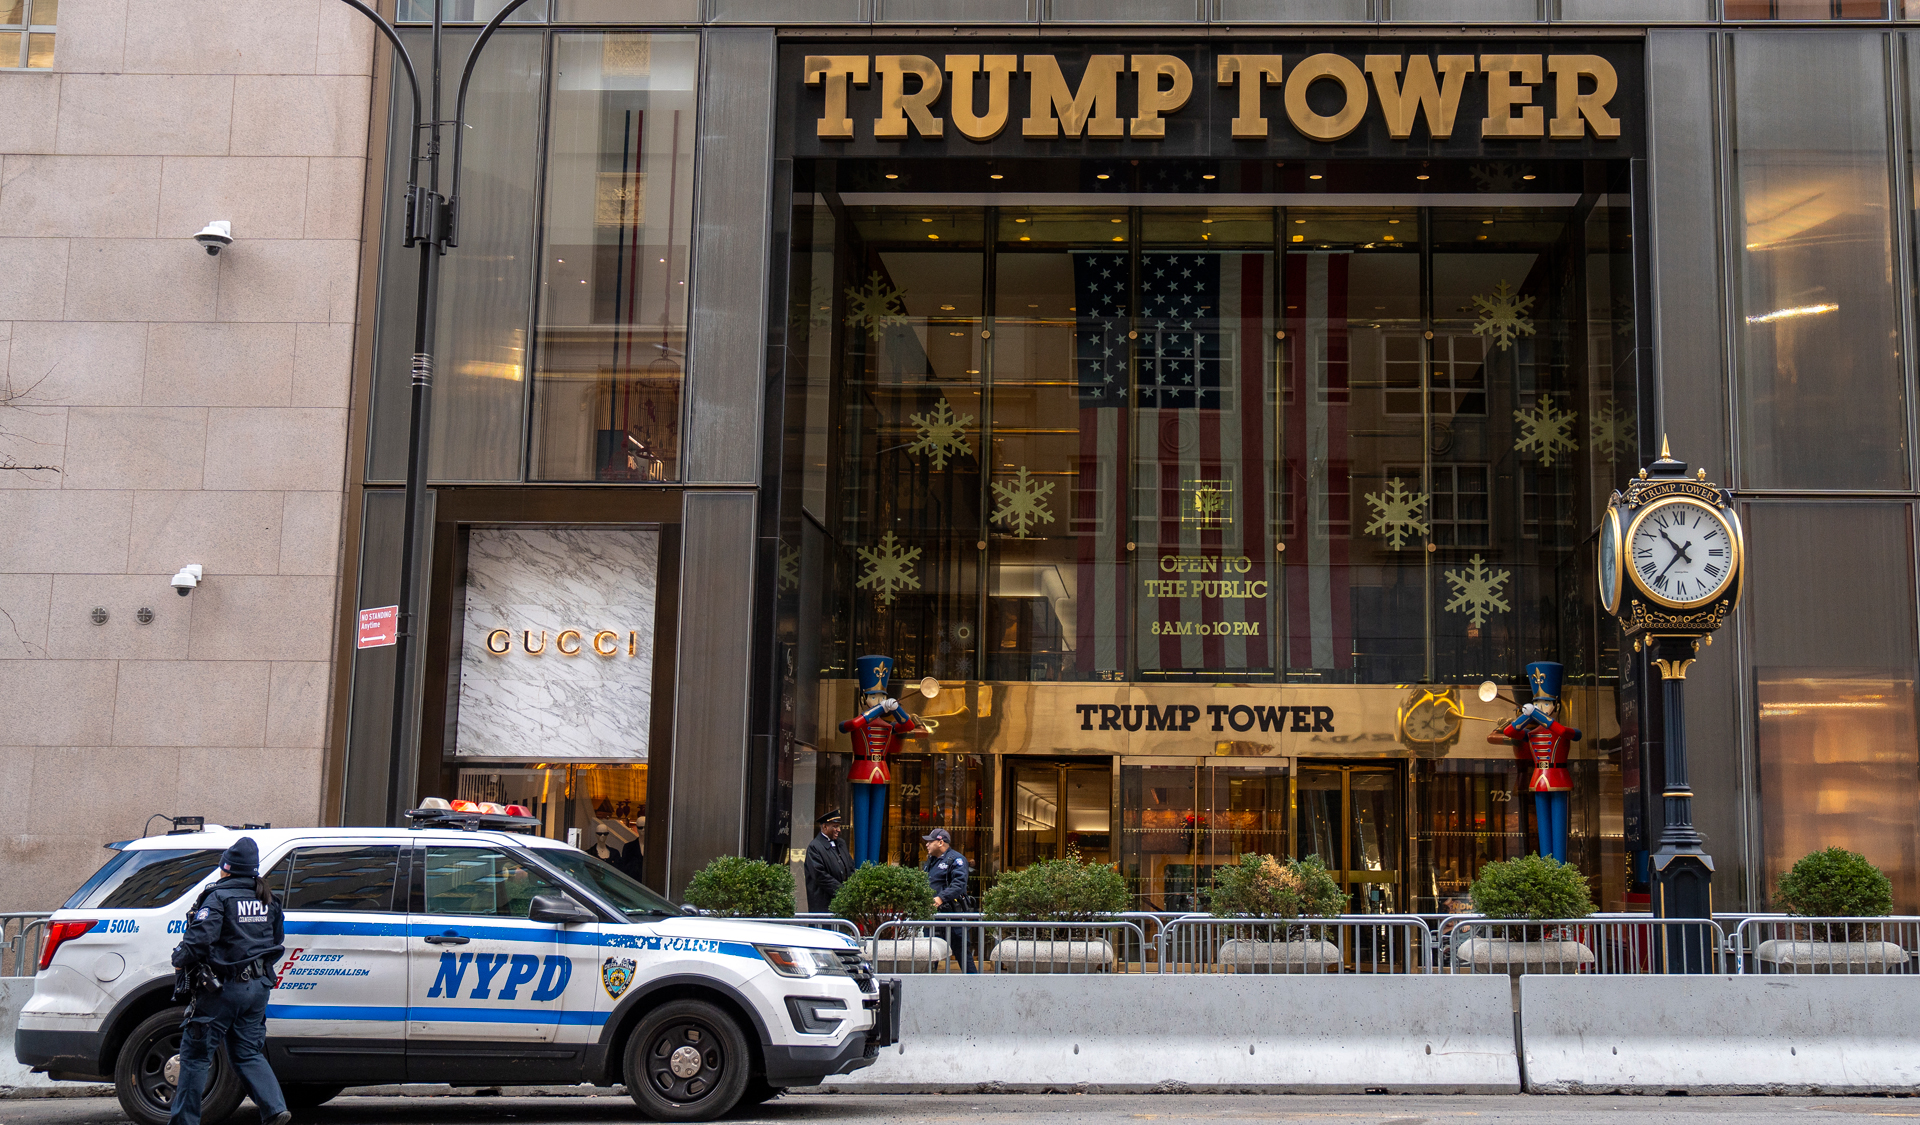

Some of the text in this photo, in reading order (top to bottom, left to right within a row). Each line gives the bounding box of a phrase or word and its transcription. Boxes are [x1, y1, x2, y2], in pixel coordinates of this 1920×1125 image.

[803, 53, 1622, 142] TRUMP TOWER
[1641, 484, 1714, 500] TRUMP TOWER
[1160, 555, 1252, 573] OPEN TO
[1144, 580, 1268, 598] THE PUBLIC
[361, 610, 392, 622] NO STANDING
[361, 621, 381, 630] Anytime
[1195, 623, 1211, 636] to
[486, 629, 637, 657] GUCCI
[1076, 704, 1335, 733] TRUMP TOWER
[901, 783, 921, 796] 725
[1490, 790, 1512, 802] 725
[237, 900, 269, 916] NYPD
[1452, 902, 1473, 910] NOW
[289, 948, 344, 962] COURTESY
[278, 962, 371, 976] PROFESSIONALISM
[427, 952, 573, 1001] NYPD
